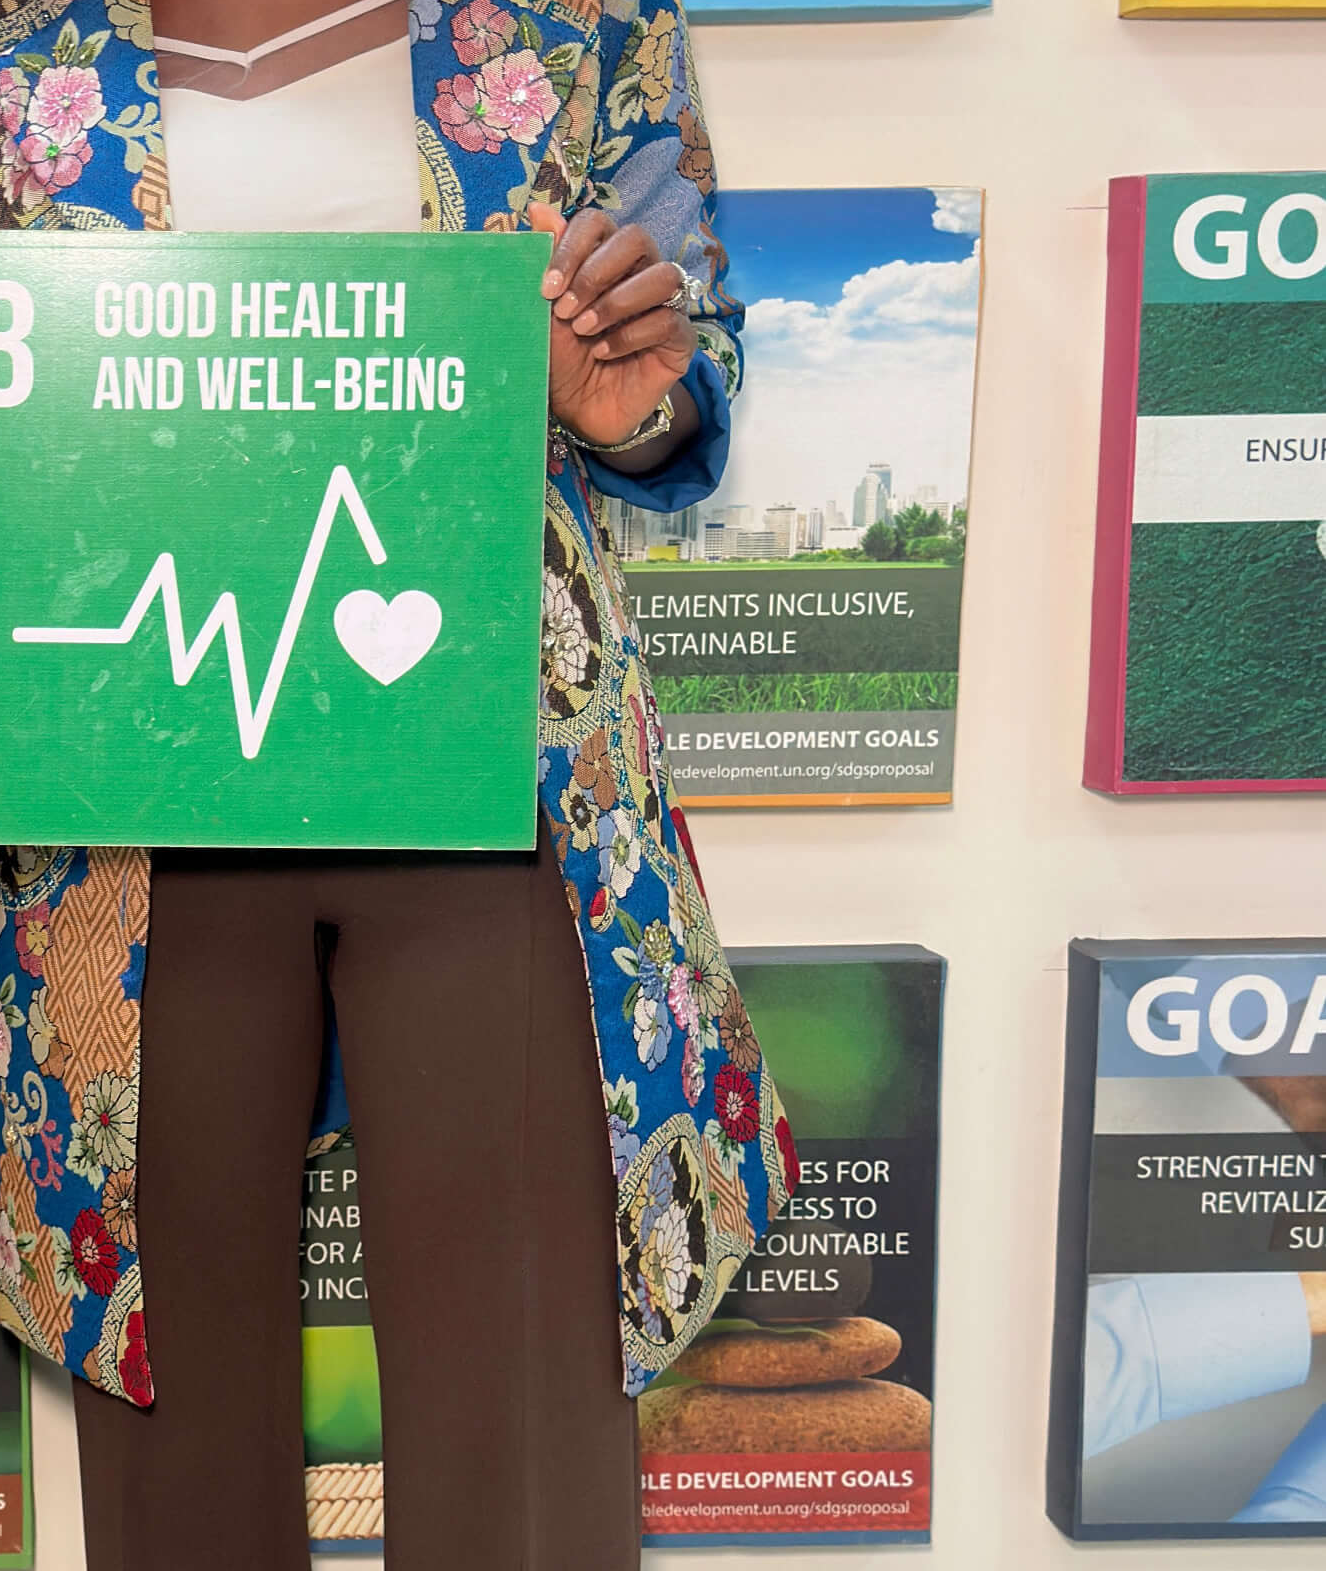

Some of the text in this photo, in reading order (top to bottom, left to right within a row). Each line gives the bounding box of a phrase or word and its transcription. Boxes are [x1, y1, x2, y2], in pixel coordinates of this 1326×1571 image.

[93, 281, 406, 339] GOOD HEALTH
[92, 356, 466, 412] AND WELL-BEING
[768, 592, 914, 619] INCLUSIVE,
[696, 730, 860, 751] DEVELOPMENT
[865, 729, 939, 748] GOALS
[836, 1161, 890, 1183] FOR
[1137, 1155, 1315, 1179] STRENGTHEN
[840, 1197, 877, 1219] TO
[1289, 1225, 1326, 1249] SU
[746, 1268, 840, 1292] LEVELS
[677, 1470, 838, 1490] DEVELOPMENT
[841, 1469, 914, 1488] GOALS
